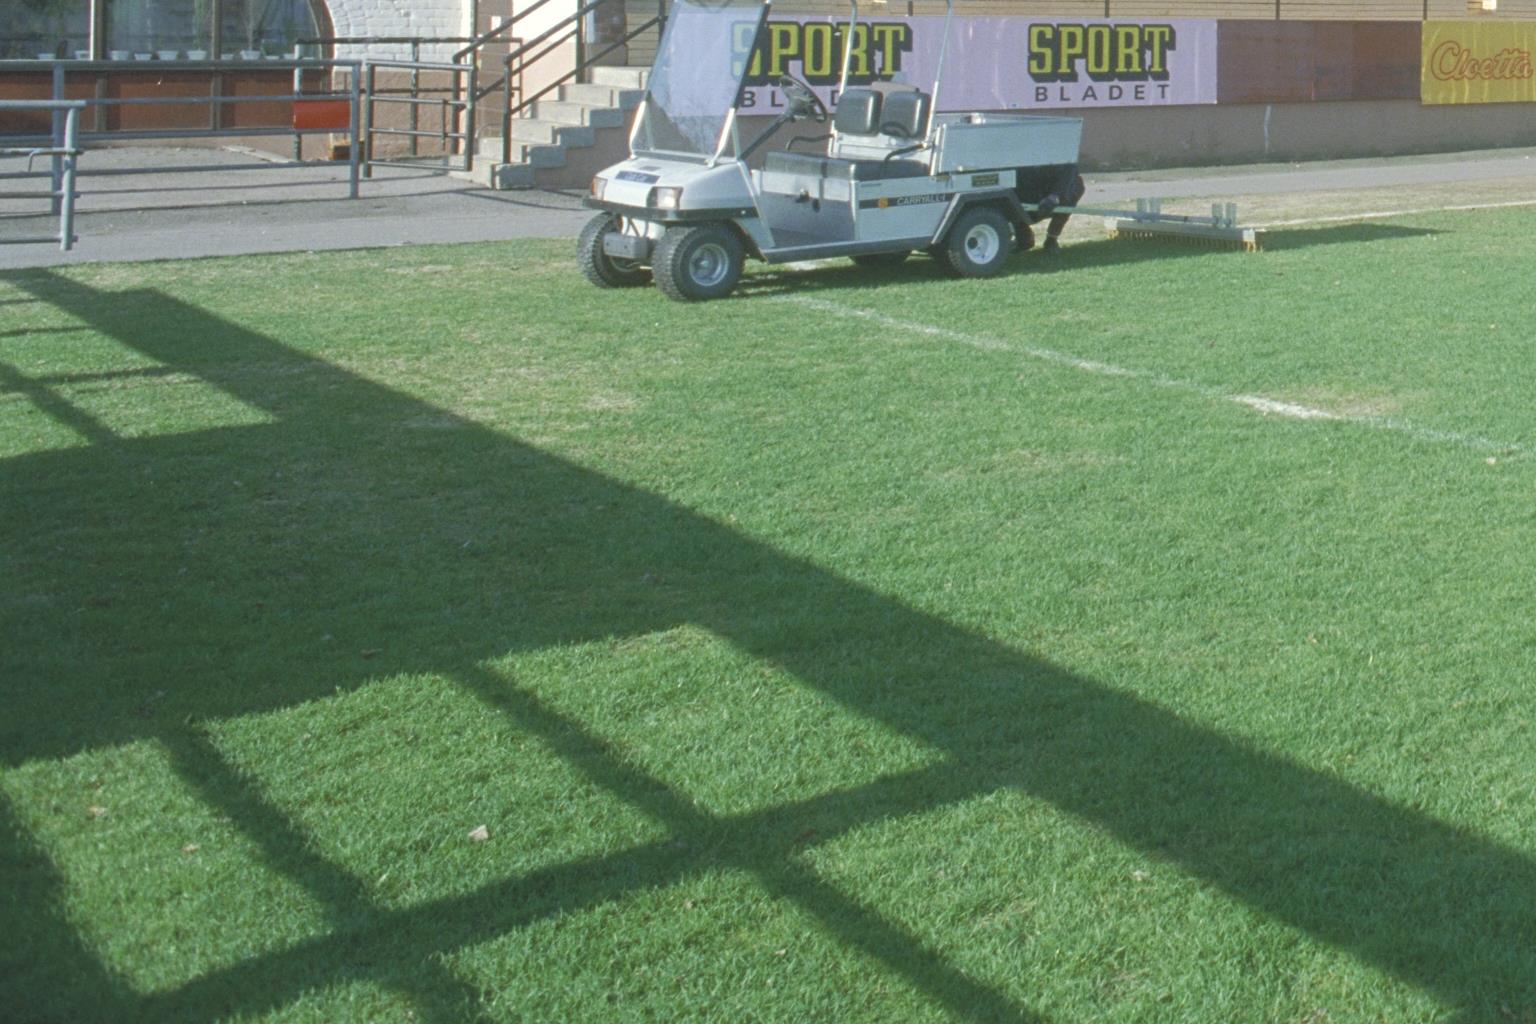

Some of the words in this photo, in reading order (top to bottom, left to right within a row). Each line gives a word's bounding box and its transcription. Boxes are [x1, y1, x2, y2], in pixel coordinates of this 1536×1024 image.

[731, 21, 913, 86] SPORT
[1028, 23, 1176, 83] SPORT
[1431, 40, 1534, 81] Cloetta
[1035, 85, 1169, 102] BLADET
